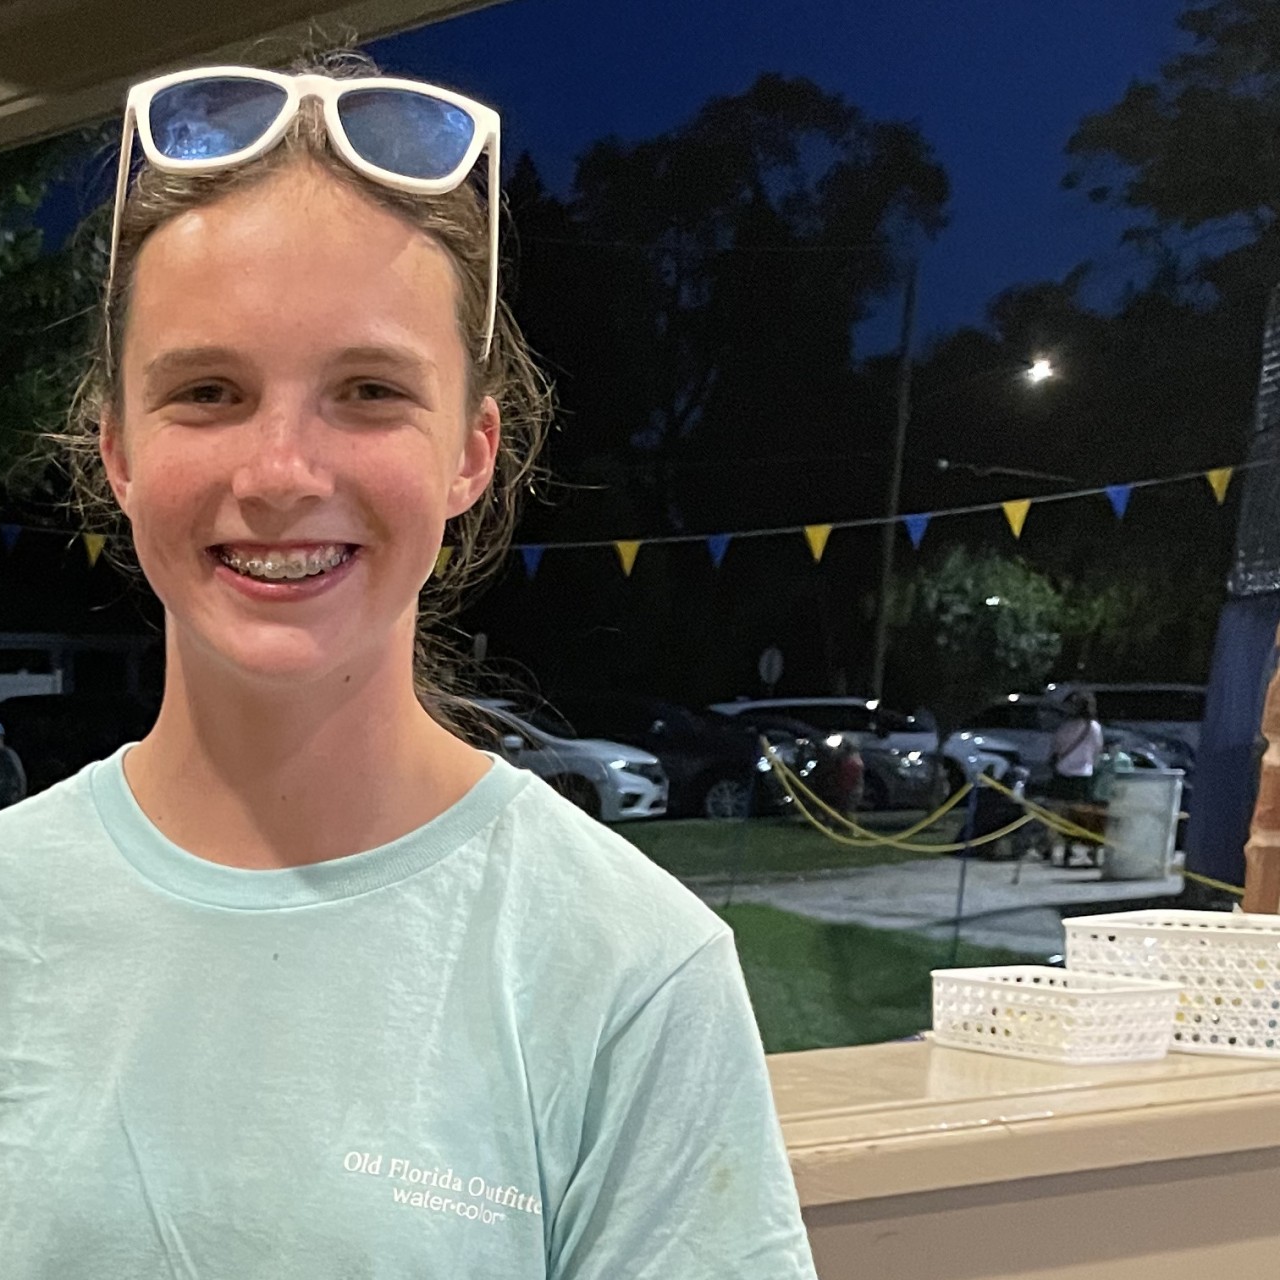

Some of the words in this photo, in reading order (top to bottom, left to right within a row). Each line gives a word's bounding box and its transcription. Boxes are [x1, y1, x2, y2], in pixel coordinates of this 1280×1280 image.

[343, 1151, 382, 1176] Old
[388, 1158, 462, 1192] Florida
[468, 1176, 543, 1215] Outfitte
